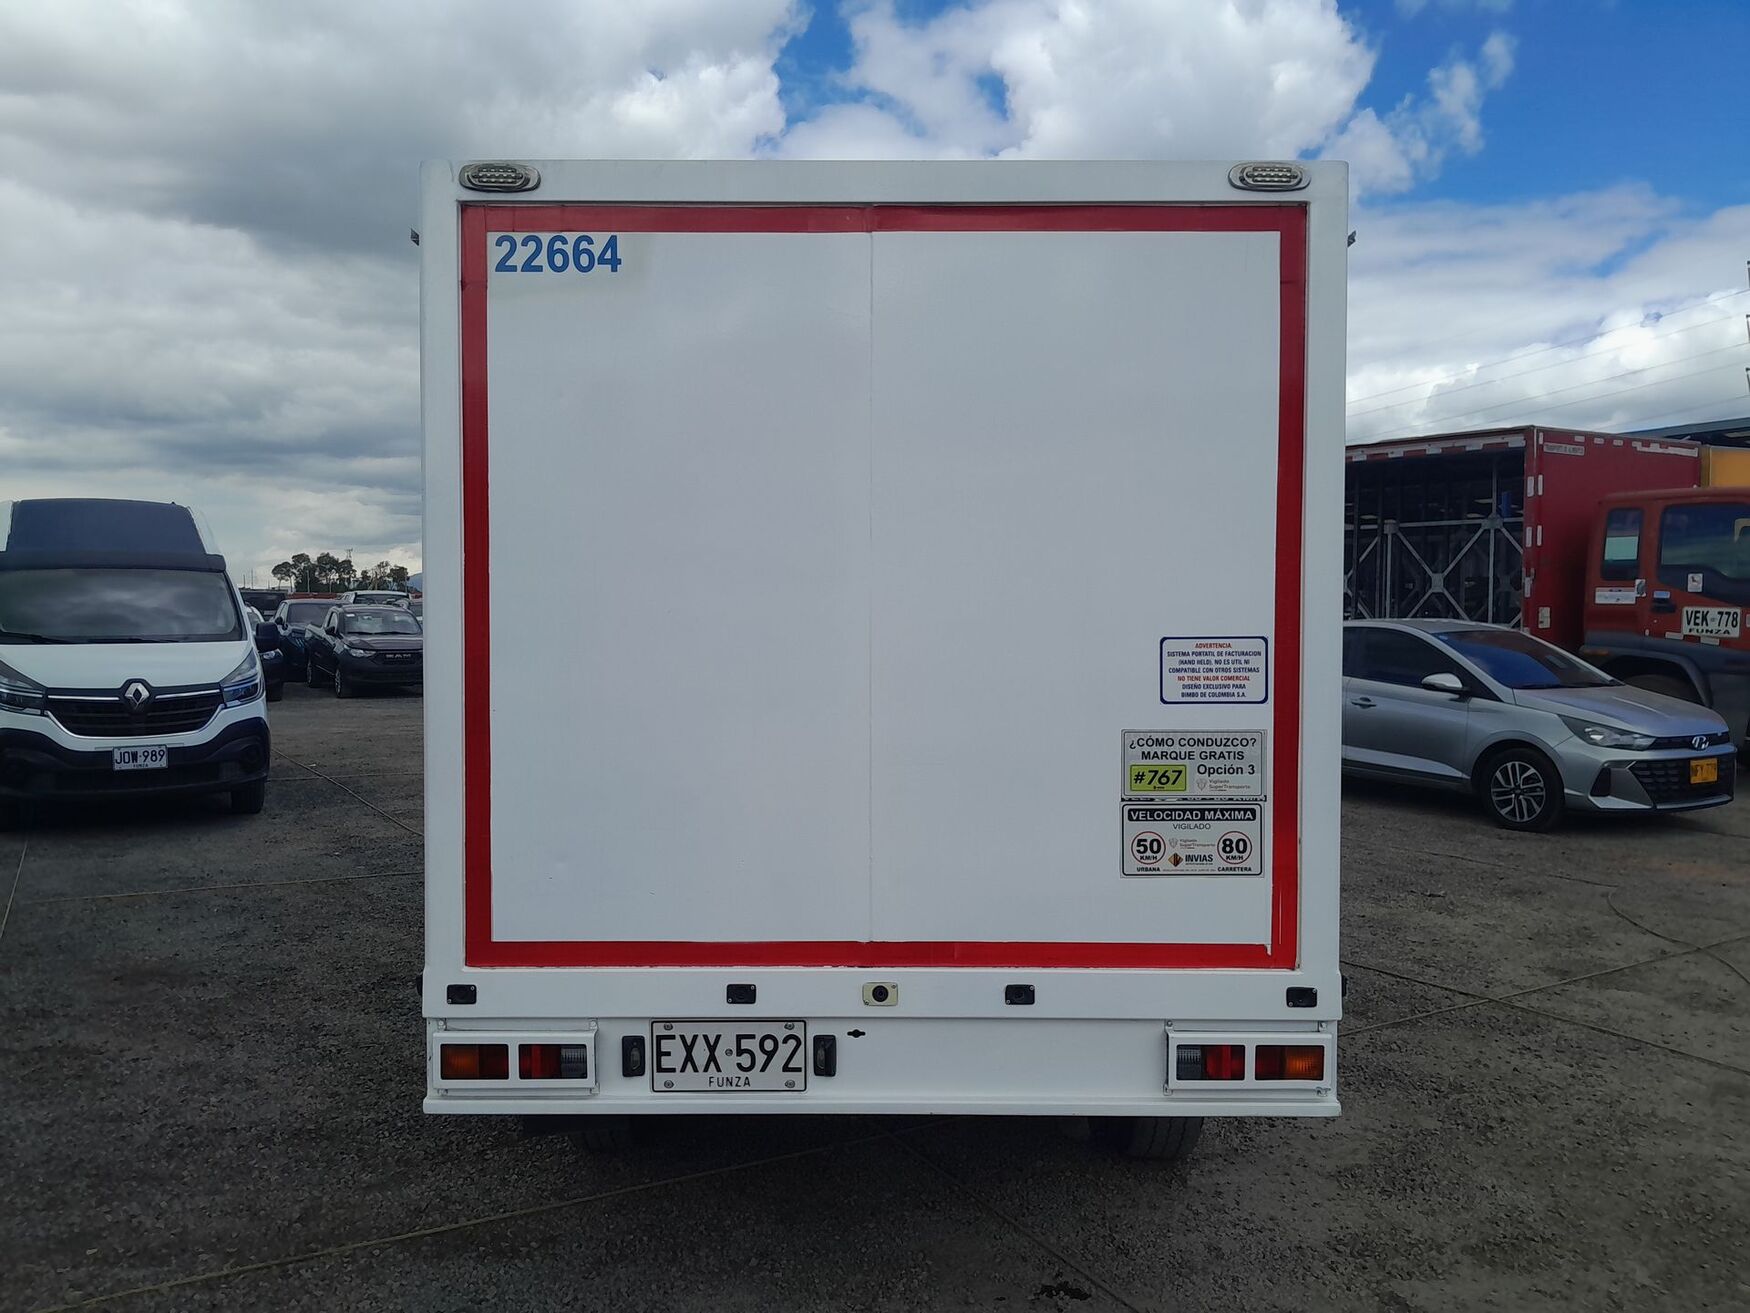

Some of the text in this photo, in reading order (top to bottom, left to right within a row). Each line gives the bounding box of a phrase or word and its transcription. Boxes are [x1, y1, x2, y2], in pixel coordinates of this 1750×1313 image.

[495, 235, 622, 273] 22664
[1129, 736, 1257, 749] ¿CÓMO CONDUZCO?
[1141, 751, 1245, 761] MARQUE GRATIS
[1133, 769, 1183, 785] #767
[1197, 764, 1255, 777] Opción 3
[1130, 809, 1254, 820] VELOCIDAD MÁXIMA
[1136, 838, 1162, 854] 50
[1221, 838, 1248, 854] 80
[1185, 854, 1213, 862] INVIAS
[708, 1077, 750, 1087] FUNZA
